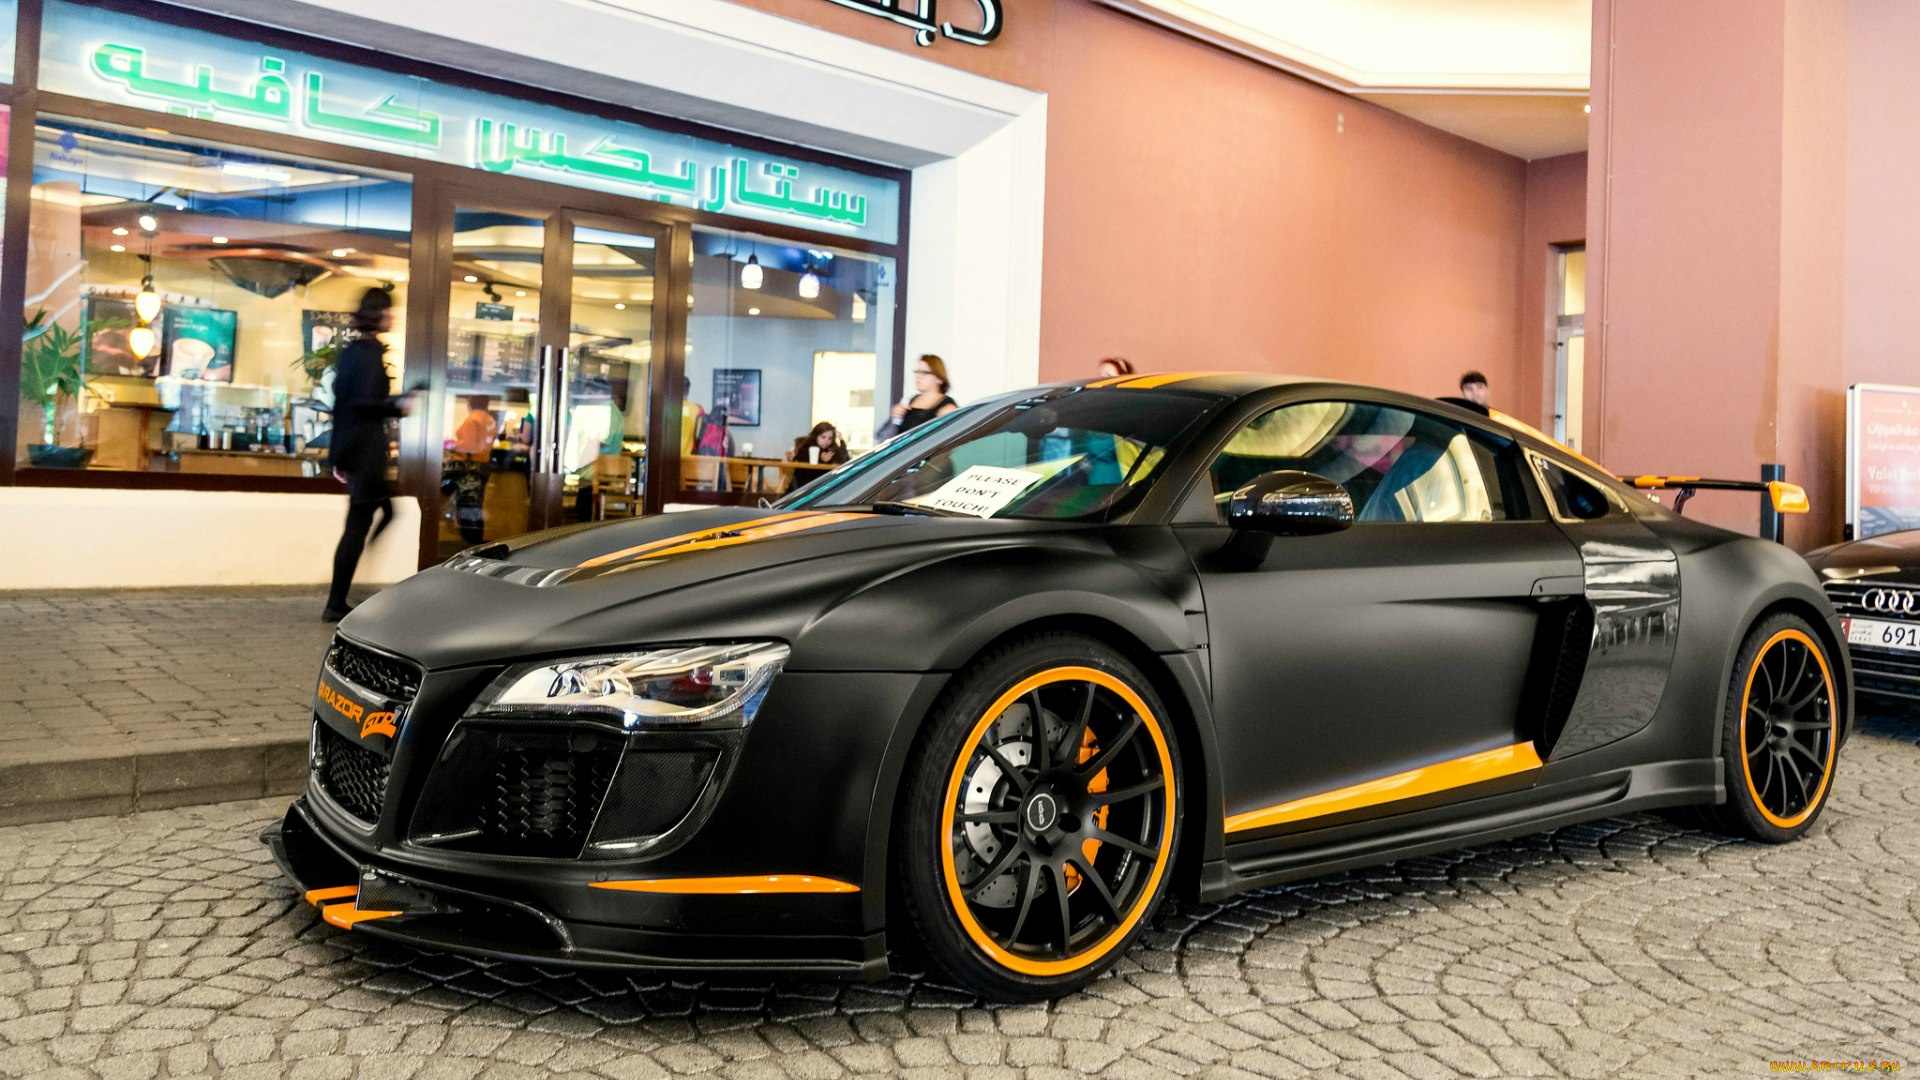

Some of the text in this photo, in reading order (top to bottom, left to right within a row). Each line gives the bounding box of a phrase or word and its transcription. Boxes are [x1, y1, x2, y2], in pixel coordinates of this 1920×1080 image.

[92, 43, 867, 226] ستاربكس كافيه
[967, 474, 1020, 486] PLEASE
[1867, 465, 1897, 481] Valet
[955, 486, 1001, 498] DON'T
[934, 499, 989, 512] TOUCH!
[1882, 625, 1920, 647] 691
